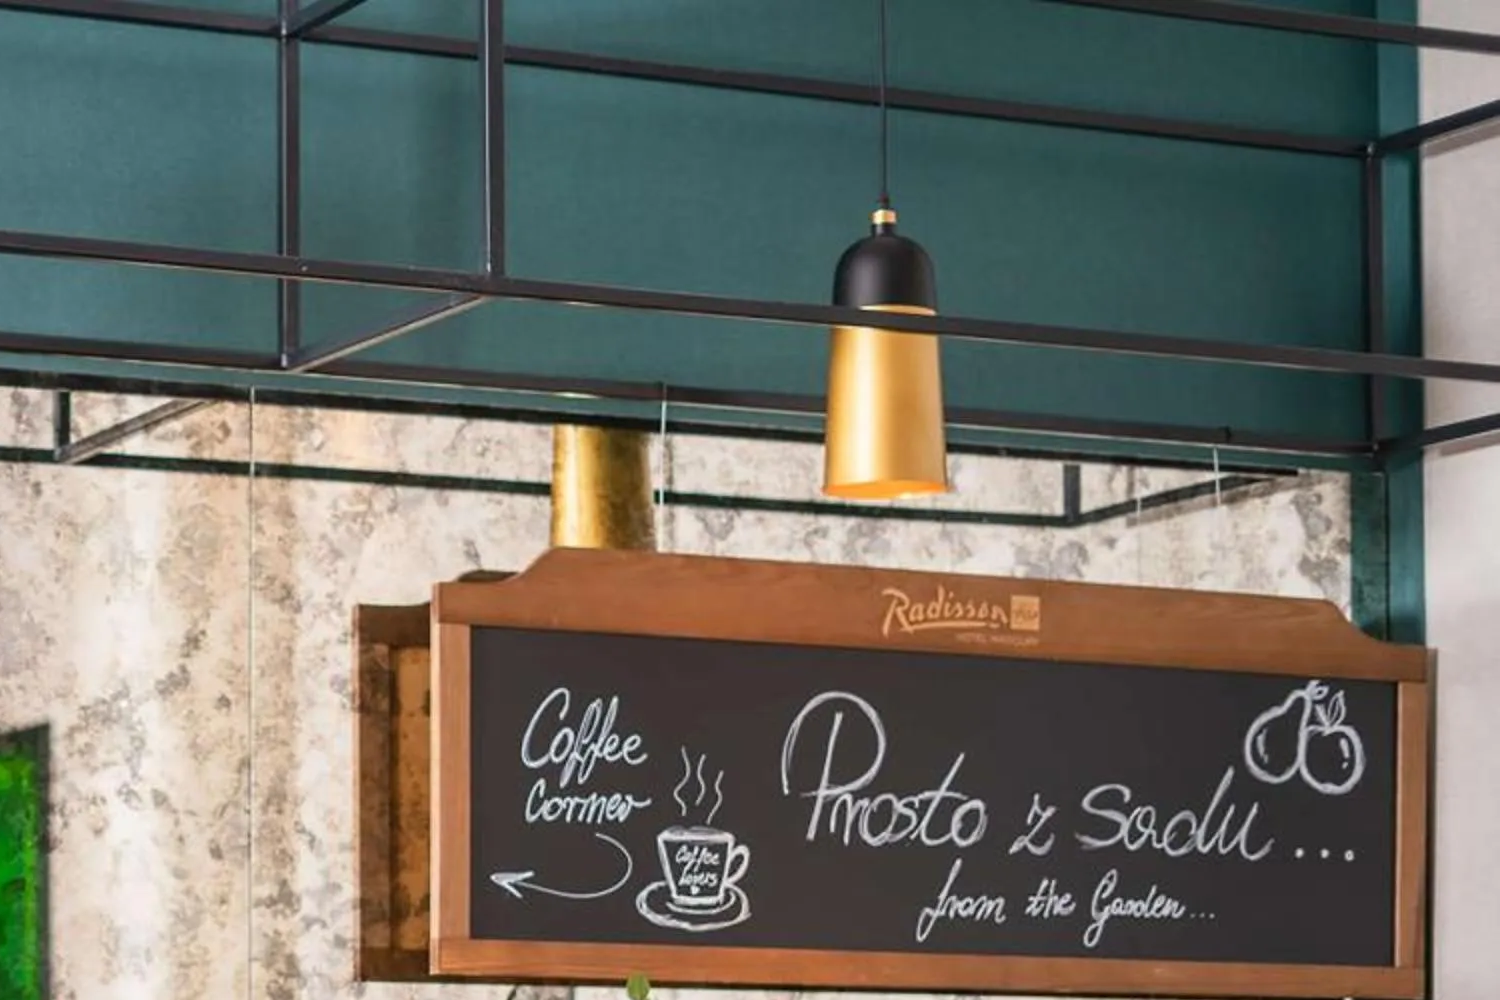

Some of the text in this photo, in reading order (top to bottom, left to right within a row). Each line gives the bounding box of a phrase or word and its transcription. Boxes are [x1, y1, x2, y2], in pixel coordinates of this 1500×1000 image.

[881, 584, 1009, 638] Radisson
[521, 686, 648, 788] Coffee
[525, 778, 652, 823] Corner
[782, 691, 987, 846] Prosto
[1008, 794, 1057, 856] z
[675, 844, 720, 872] Coffee
[915, 858, 1007, 943] from
[1024, 878, 1077, 920] the
